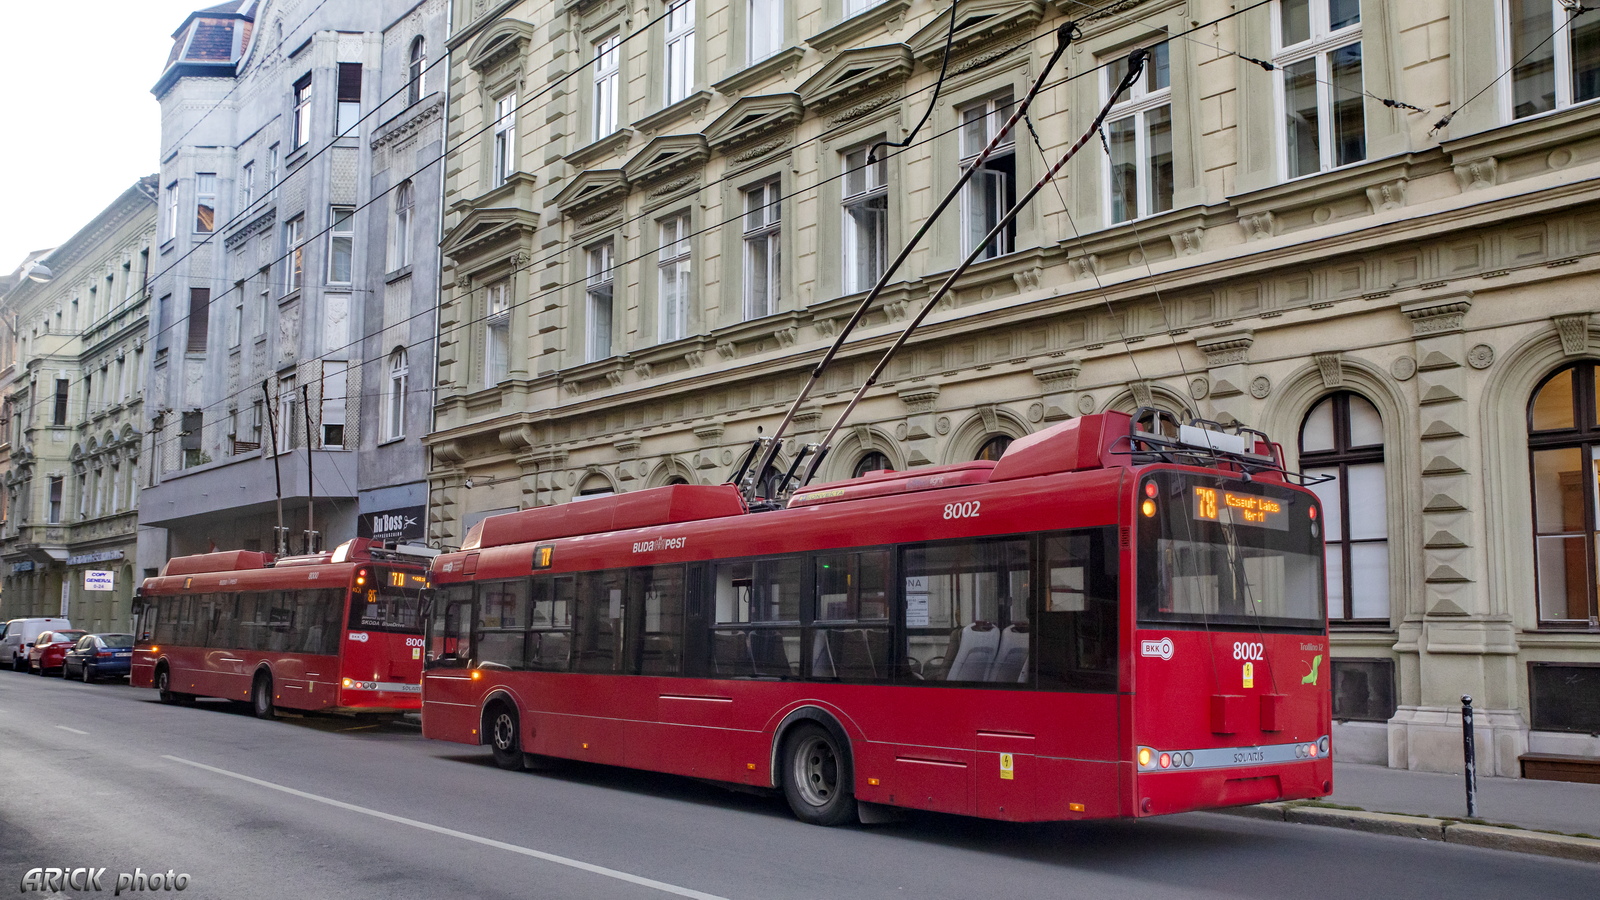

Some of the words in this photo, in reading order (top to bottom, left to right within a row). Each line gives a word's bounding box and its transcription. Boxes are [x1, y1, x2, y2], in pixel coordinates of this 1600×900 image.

[943, 500, 981, 520] 8002
[1196, 488, 1217, 519] 78
[392, 572, 405, 586] 70
[1233, 641, 1264, 661] 8002
[1233, 752, 1264, 762] SOLARIS
